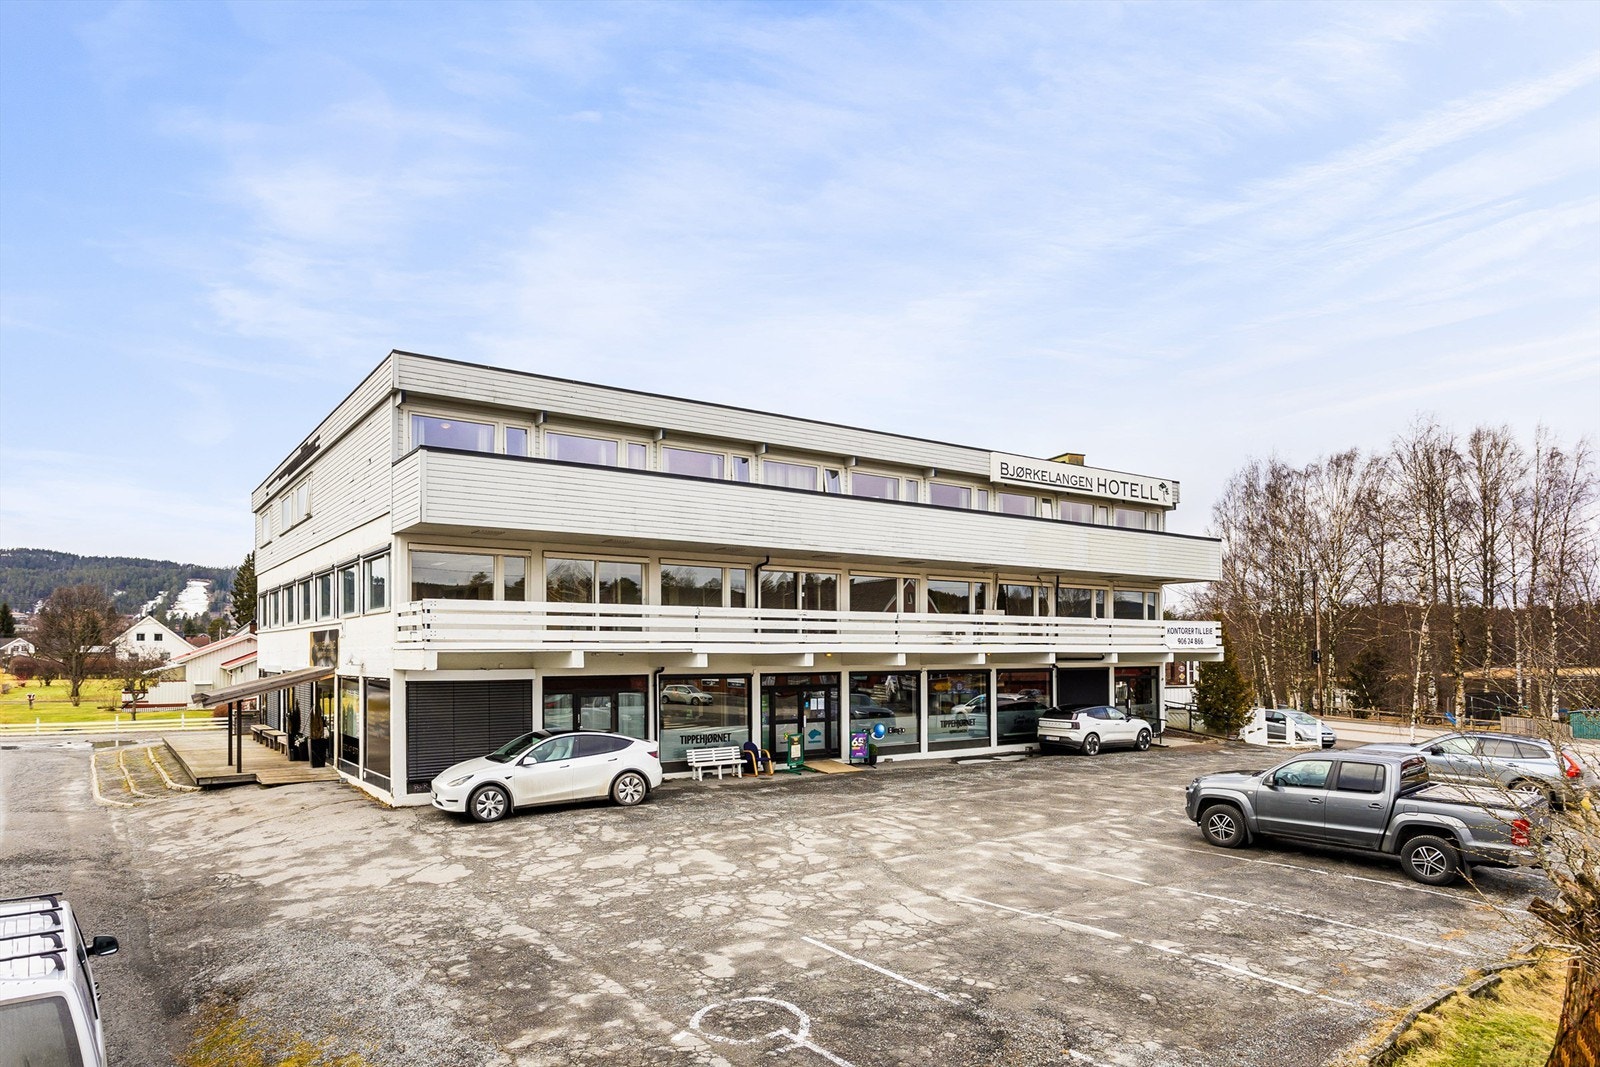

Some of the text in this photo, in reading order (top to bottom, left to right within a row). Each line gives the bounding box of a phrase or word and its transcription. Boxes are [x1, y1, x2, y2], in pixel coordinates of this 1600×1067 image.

[1000, 462, 1159, 501] BJØRKELANGEN HOTELL
[1166, 627, 1194, 635] KONTORER
[1203, 627, 1213, 635] LEIE
[680, 732, 732, 745] TIPPEHJØRNET
